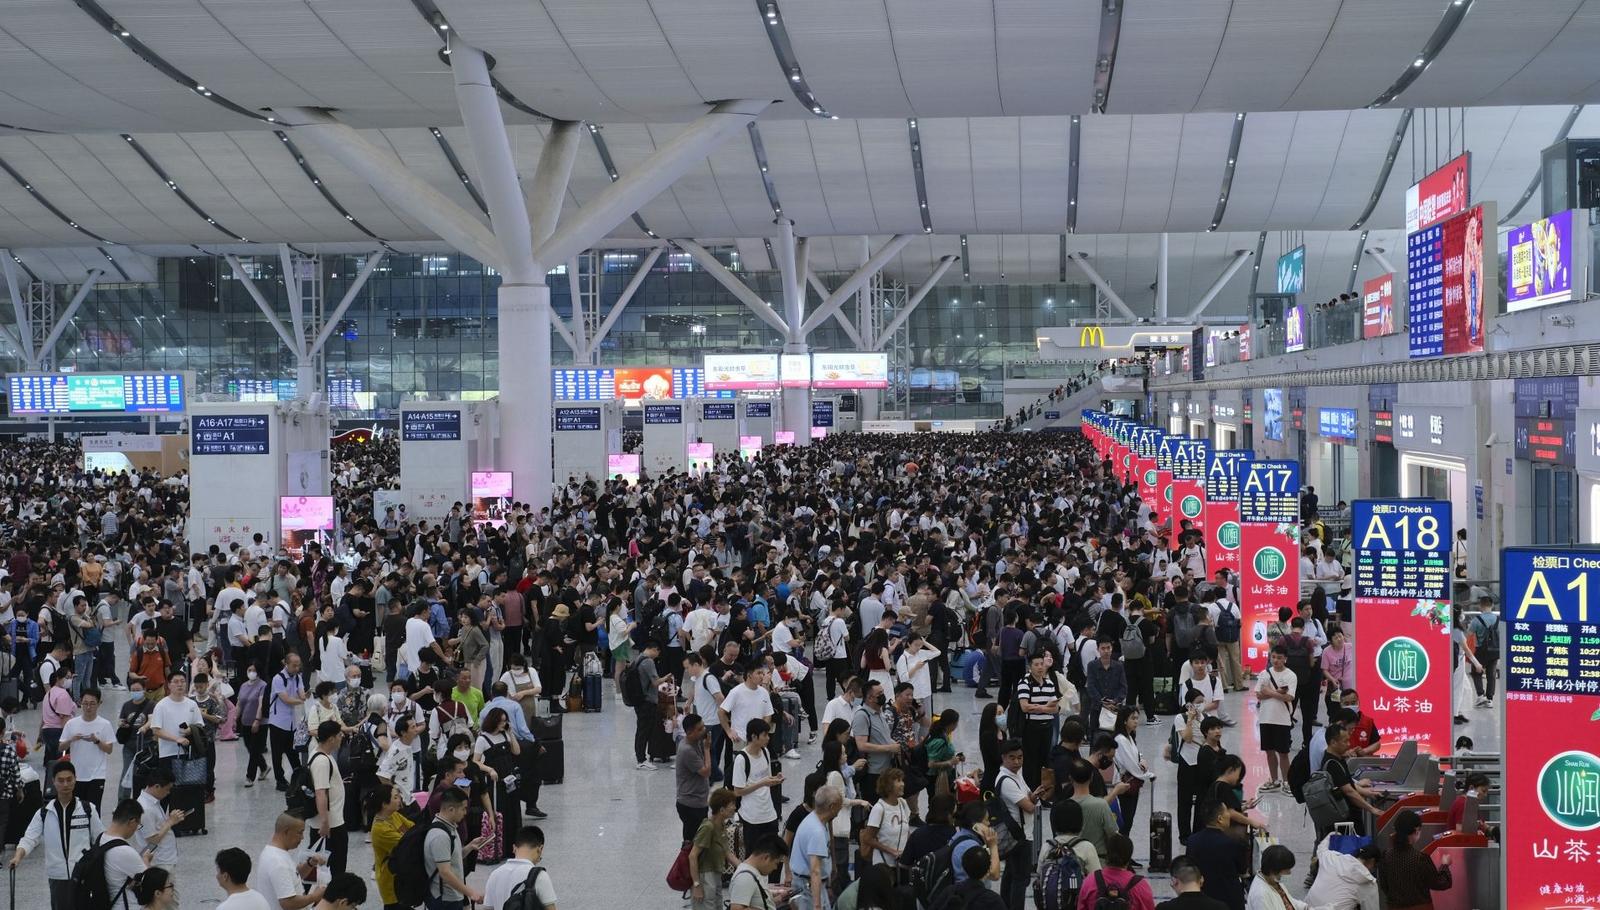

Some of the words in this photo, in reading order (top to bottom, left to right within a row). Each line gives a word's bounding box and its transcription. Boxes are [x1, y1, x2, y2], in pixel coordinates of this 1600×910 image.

[223, 432, 235, 440] A1
[1175, 445, 1206, 460] A15
[1244, 470, 1292, 492] A17
[1372, 505, 1397, 513] 检票口
[1362, 514, 1440, 550] A18
[1533, 556, 1570, 568] 检票口
[1252, 584, 1288, 595] 山茶油
[1364, 588, 1441, 598] 开车前4分钟停止检票
[1516, 571, 1587, 621] A1
[1514, 623, 1530, 631] 车次
[1581, 625, 1597, 633] 开点
[1546, 646, 1568, 655] 广州东
[1388, 650, 1417, 681] 山润
[1521, 678, 1600, 692] 开车前4分钟停
[1374, 696, 1433, 713] 山茶油
[1556, 770, 1600, 816] 山润
[1533, 838, 1600, 863] 山茶
